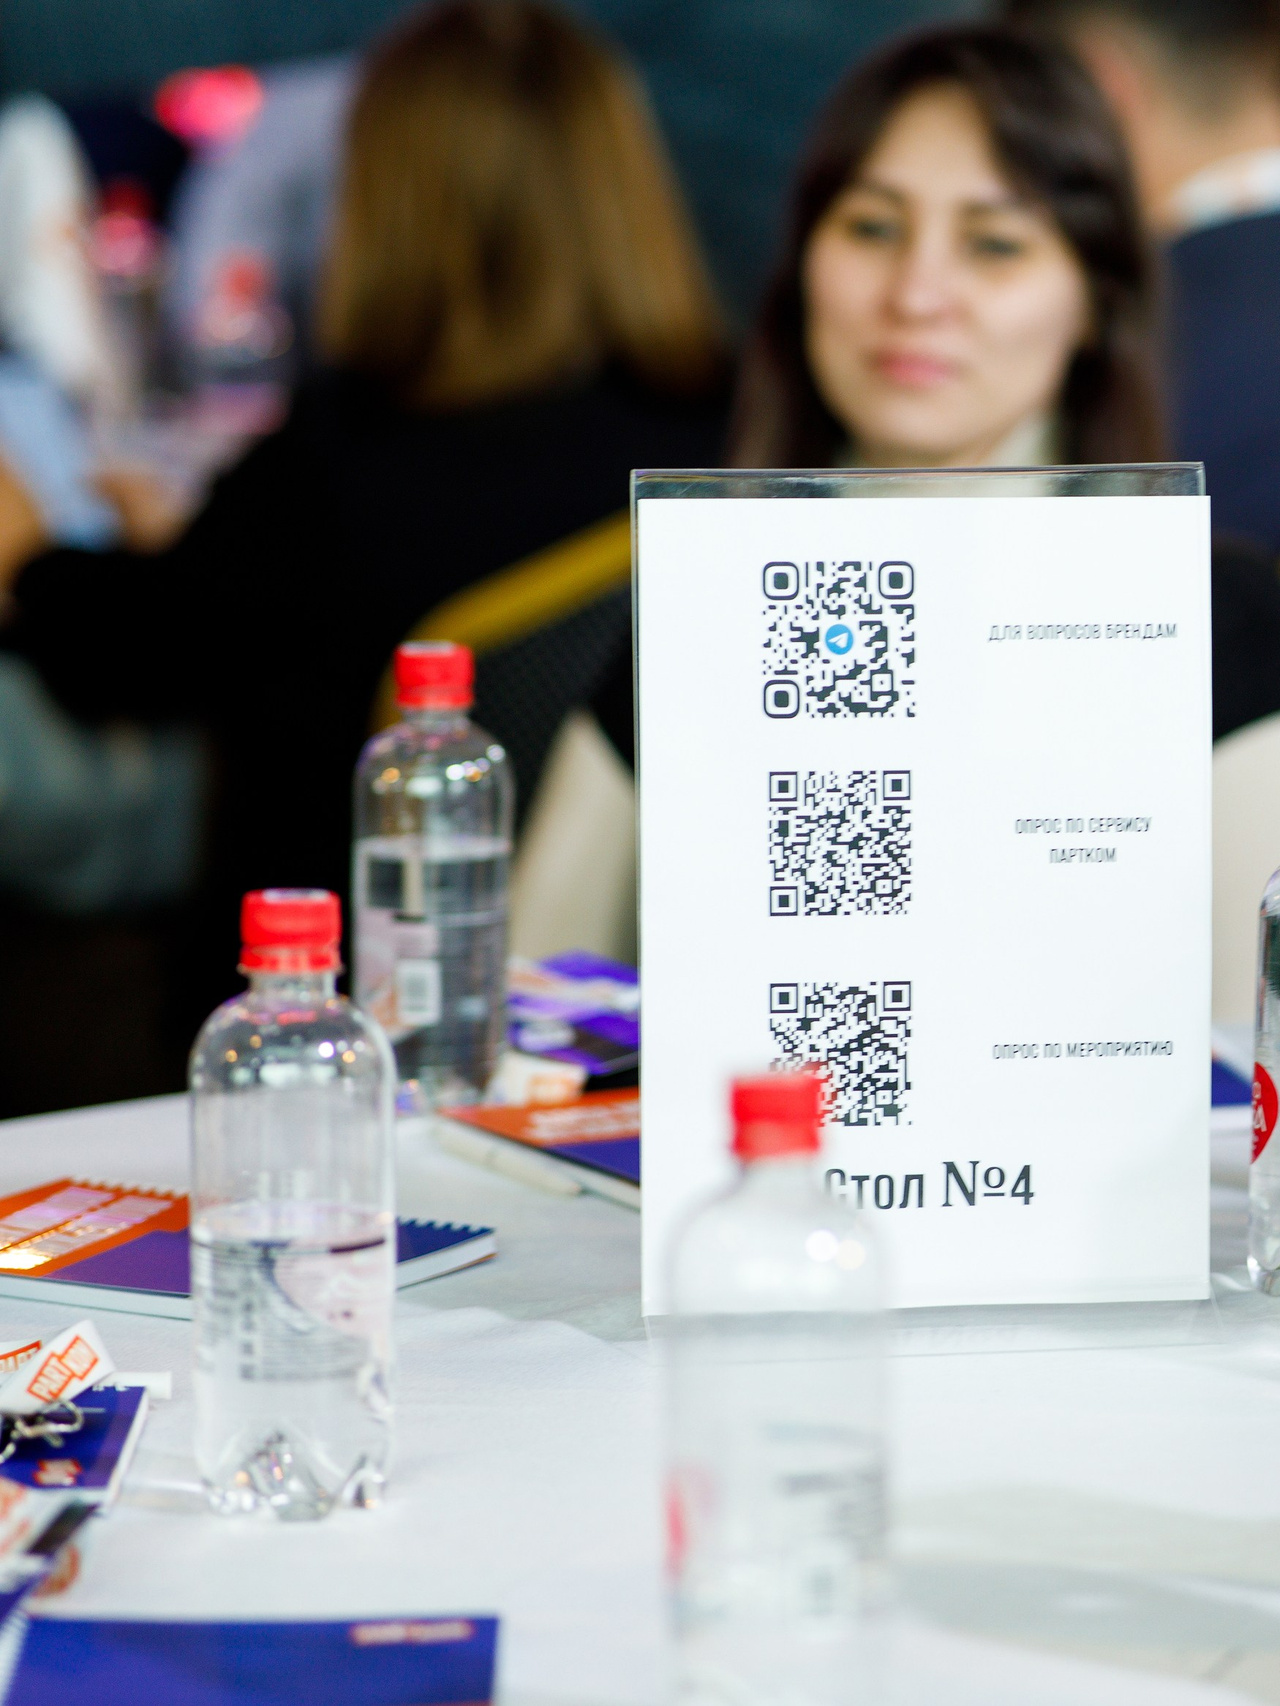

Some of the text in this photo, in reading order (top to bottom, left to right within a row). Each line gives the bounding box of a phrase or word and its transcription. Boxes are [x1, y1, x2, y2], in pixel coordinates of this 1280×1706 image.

[989, 622, 1178, 642] ДЛЯ ВОПРОСОВ БРЕНДАМ
[1014, 815, 1152, 835] ОПРОС ПО СЕРВИСУ
[1049, 846, 1117, 864] ПАРТКОМ
[993, 1040, 1175, 1060] ОПРОС ПО МЕРОПРИЯТИЮ
[824, 1159, 1034, 1210] Стол №4
